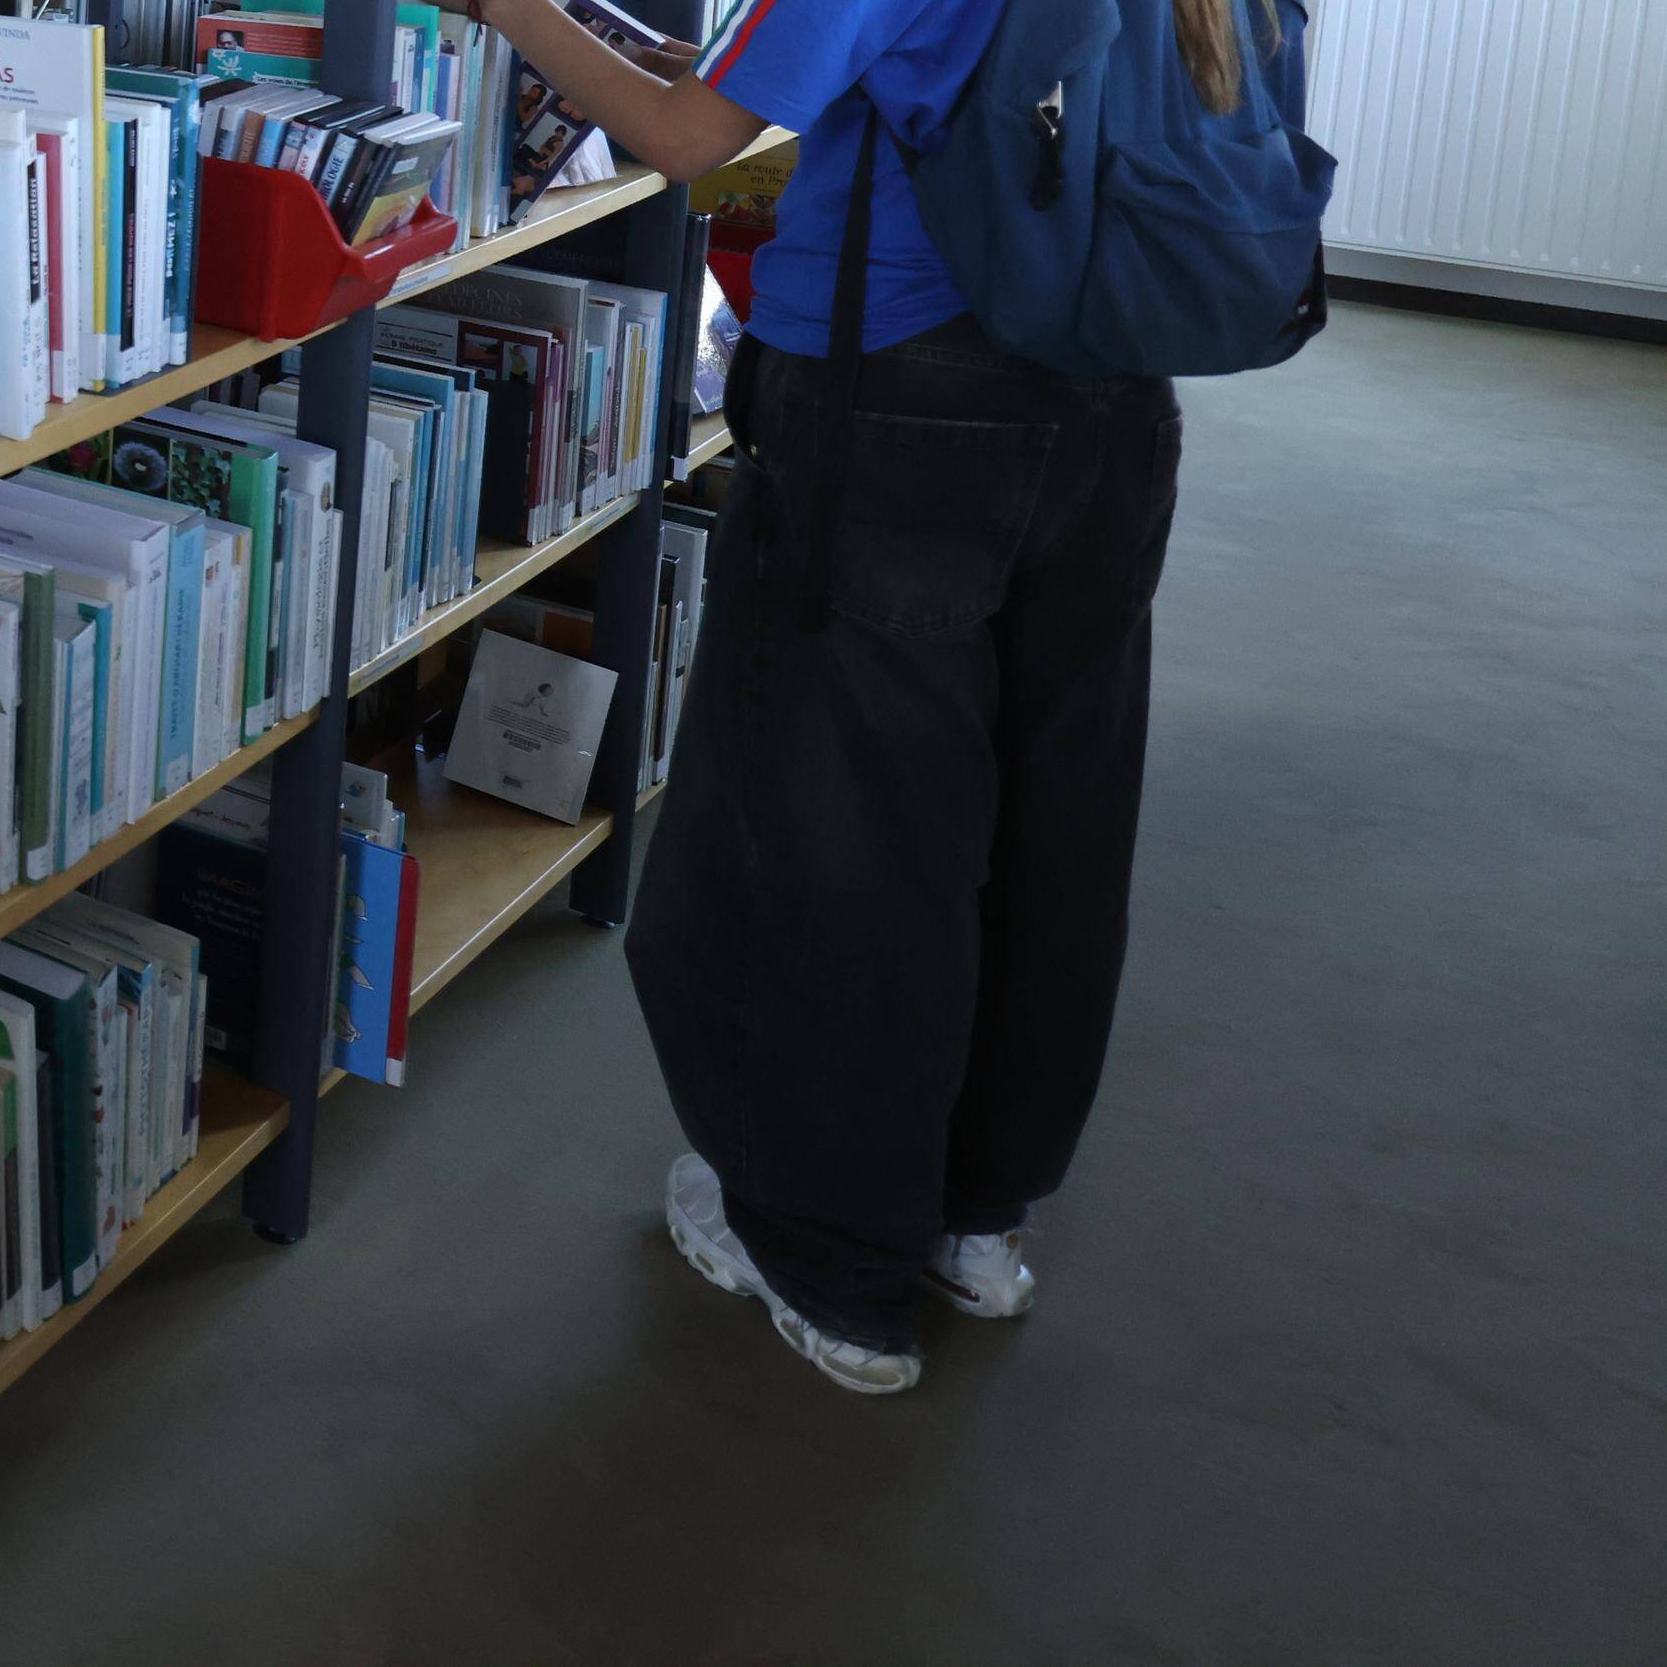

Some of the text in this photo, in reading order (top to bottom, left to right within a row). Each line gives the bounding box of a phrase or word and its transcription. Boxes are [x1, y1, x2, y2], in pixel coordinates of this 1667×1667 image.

[753, 164, 783, 175] route
[749, 176, 764, 184] en
[28, 176, 39, 285] La Relaxation
